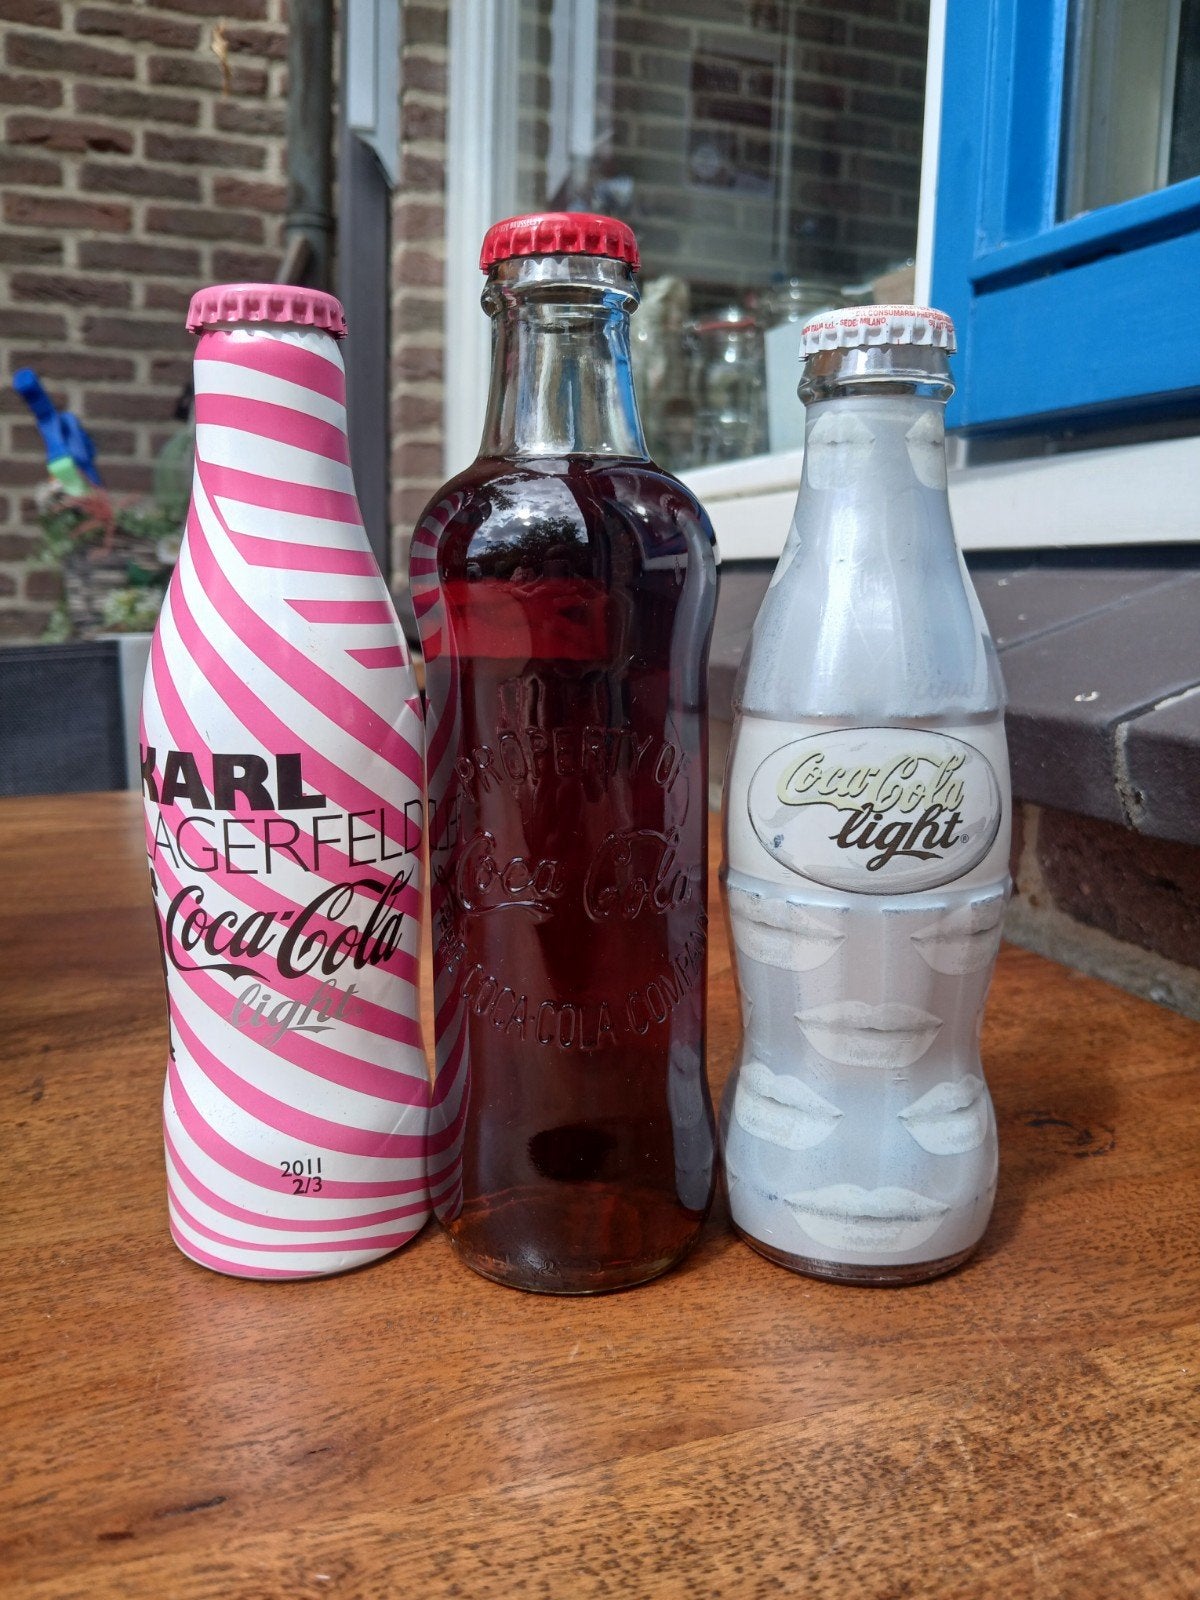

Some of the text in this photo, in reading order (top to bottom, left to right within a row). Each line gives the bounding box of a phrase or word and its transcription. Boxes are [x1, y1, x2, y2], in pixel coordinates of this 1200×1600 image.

[139, 742, 326, 811] KARL
[776, 751, 967, 813] Coca-Cola
[147, 798, 424, 875] AGERFELD
[166, 863, 415, 983] Coca-Cola
[280, 1157, 322, 1178] 2011
[292, 1176, 323, 1195] 2/3
